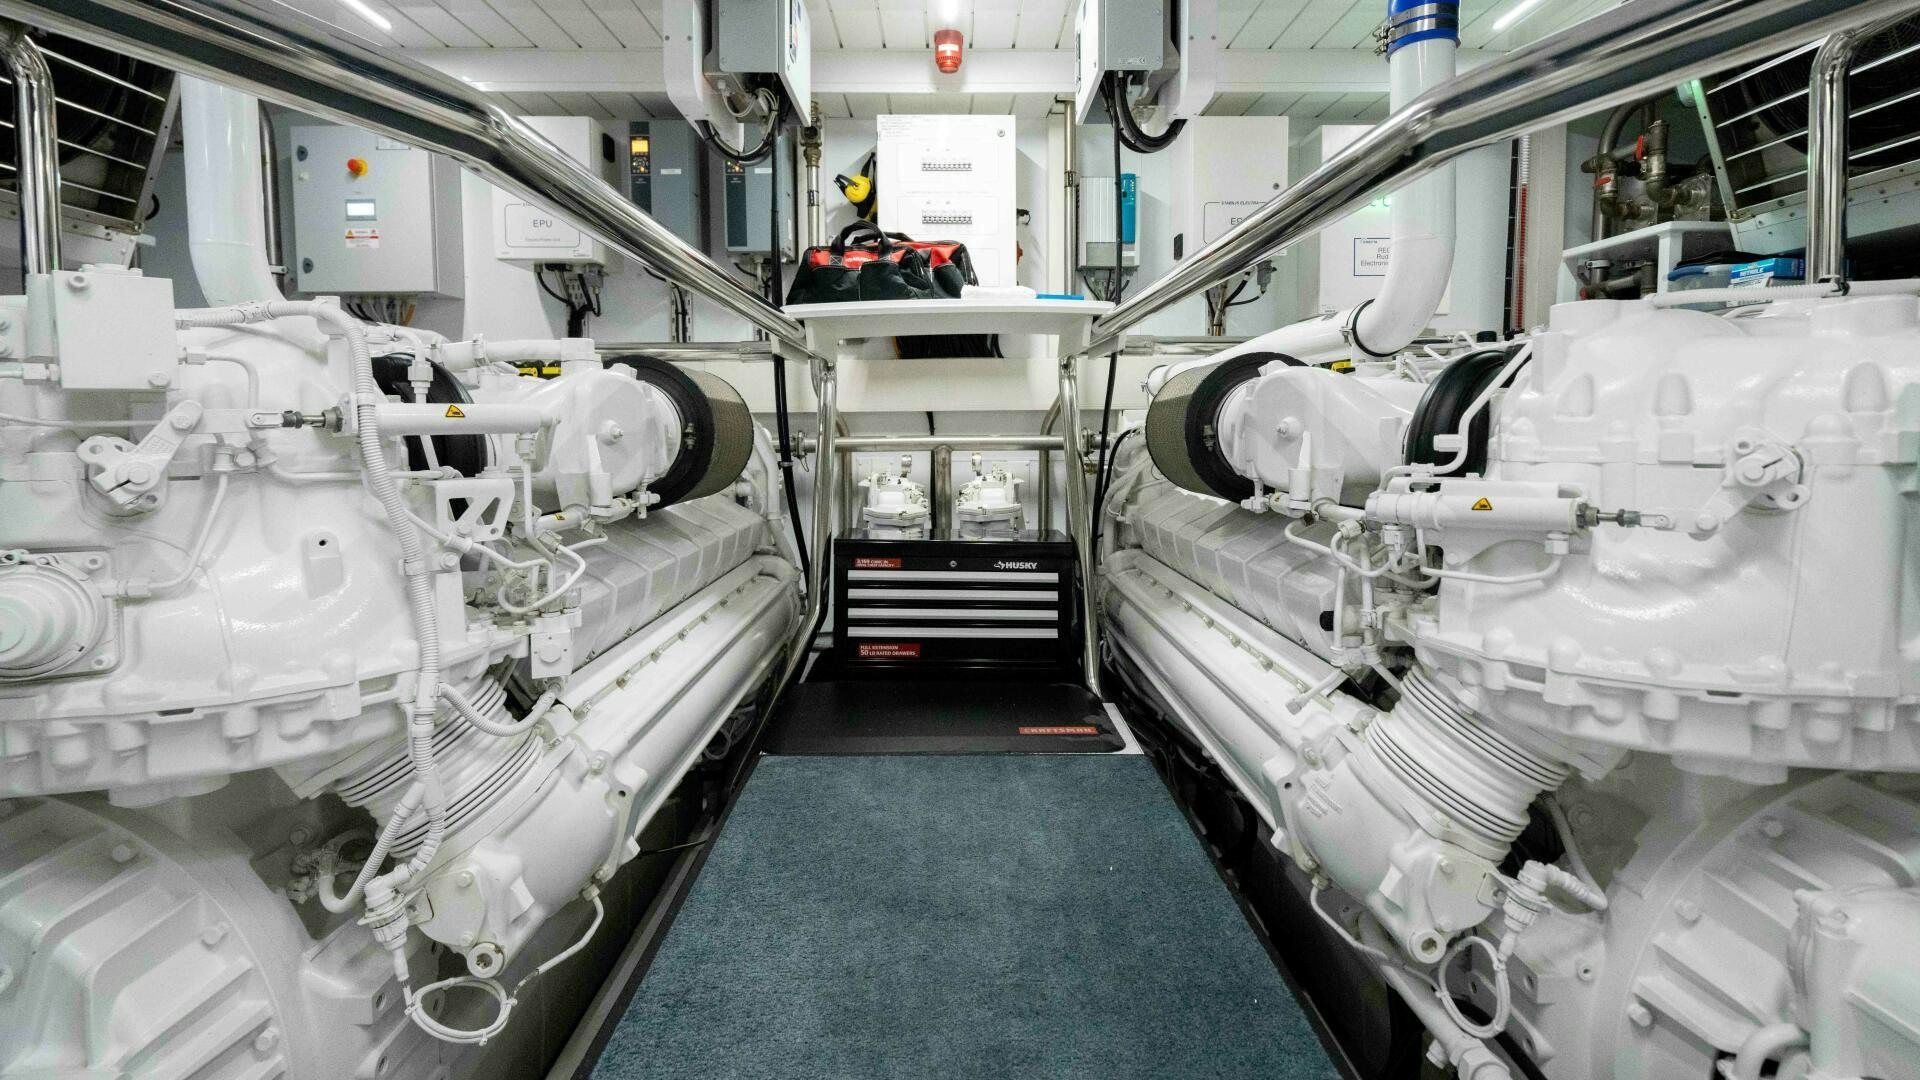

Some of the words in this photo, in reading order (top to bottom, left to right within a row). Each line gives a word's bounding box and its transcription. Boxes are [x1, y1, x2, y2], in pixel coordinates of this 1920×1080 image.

[532, 219, 552, 228] EPU
[1230, 217, 1243, 225] EP
[1005, 561, 1038, 570] HUSKY
[1024, 727, 1091, 735] CRAFTSMAN
